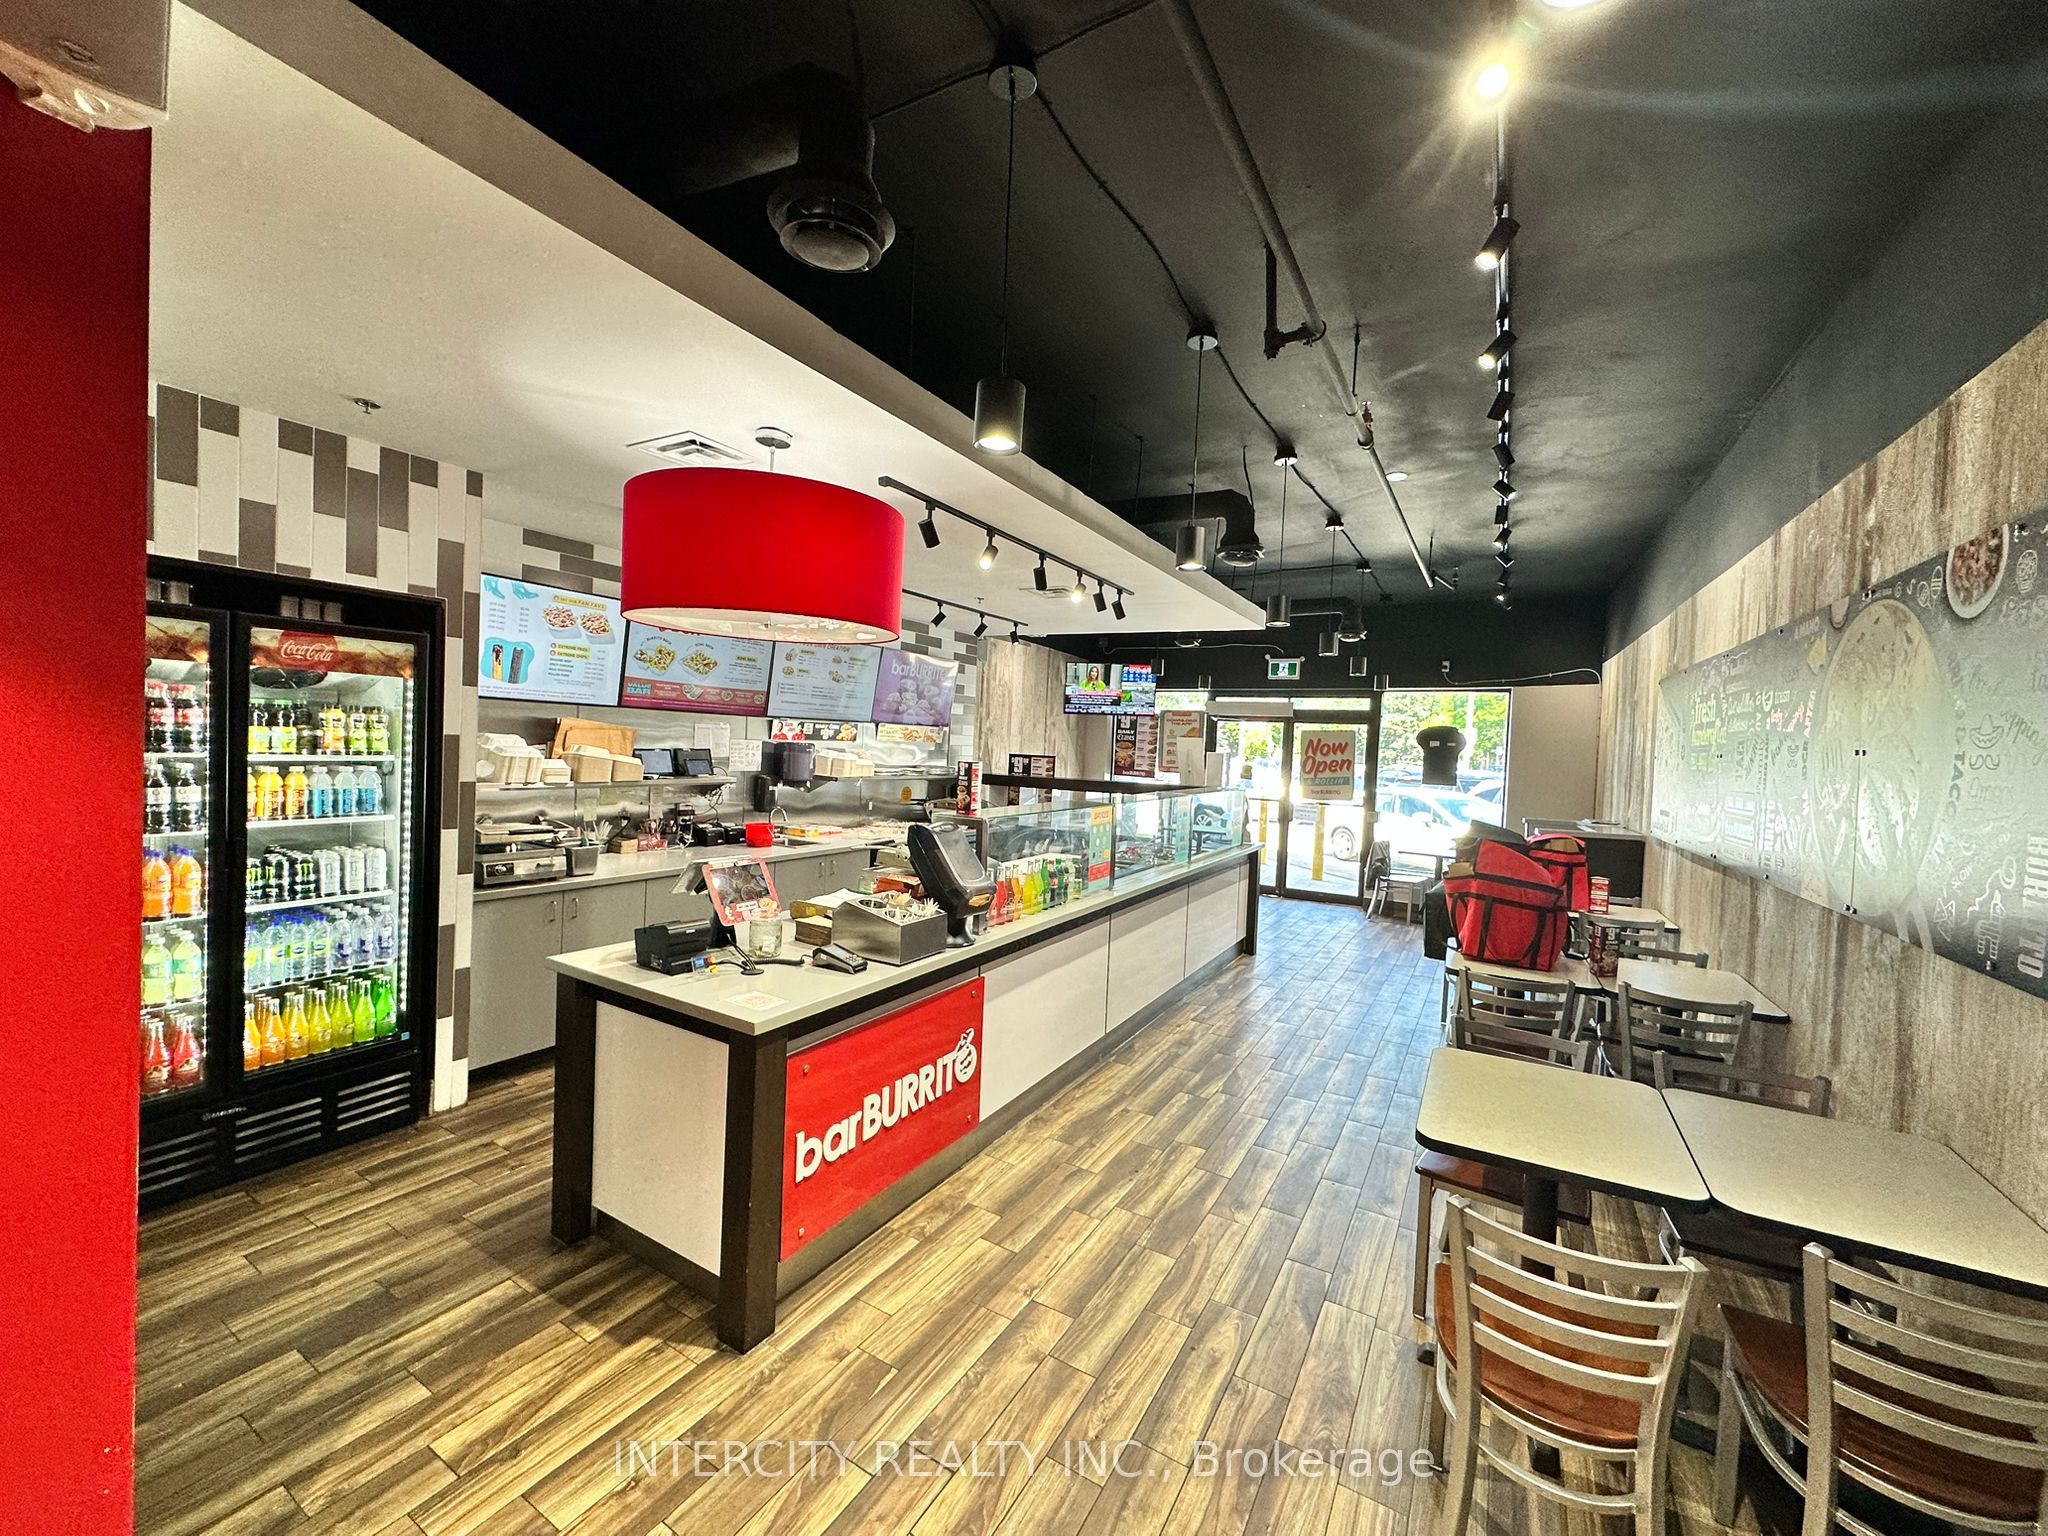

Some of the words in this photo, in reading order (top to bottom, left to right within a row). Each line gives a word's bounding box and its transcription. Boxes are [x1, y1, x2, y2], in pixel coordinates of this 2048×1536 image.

[1305, 738, 1349, 757] Now
[1302, 755, 1353, 778] Open
[795, 1028, 978, 1185] barBURRITO
